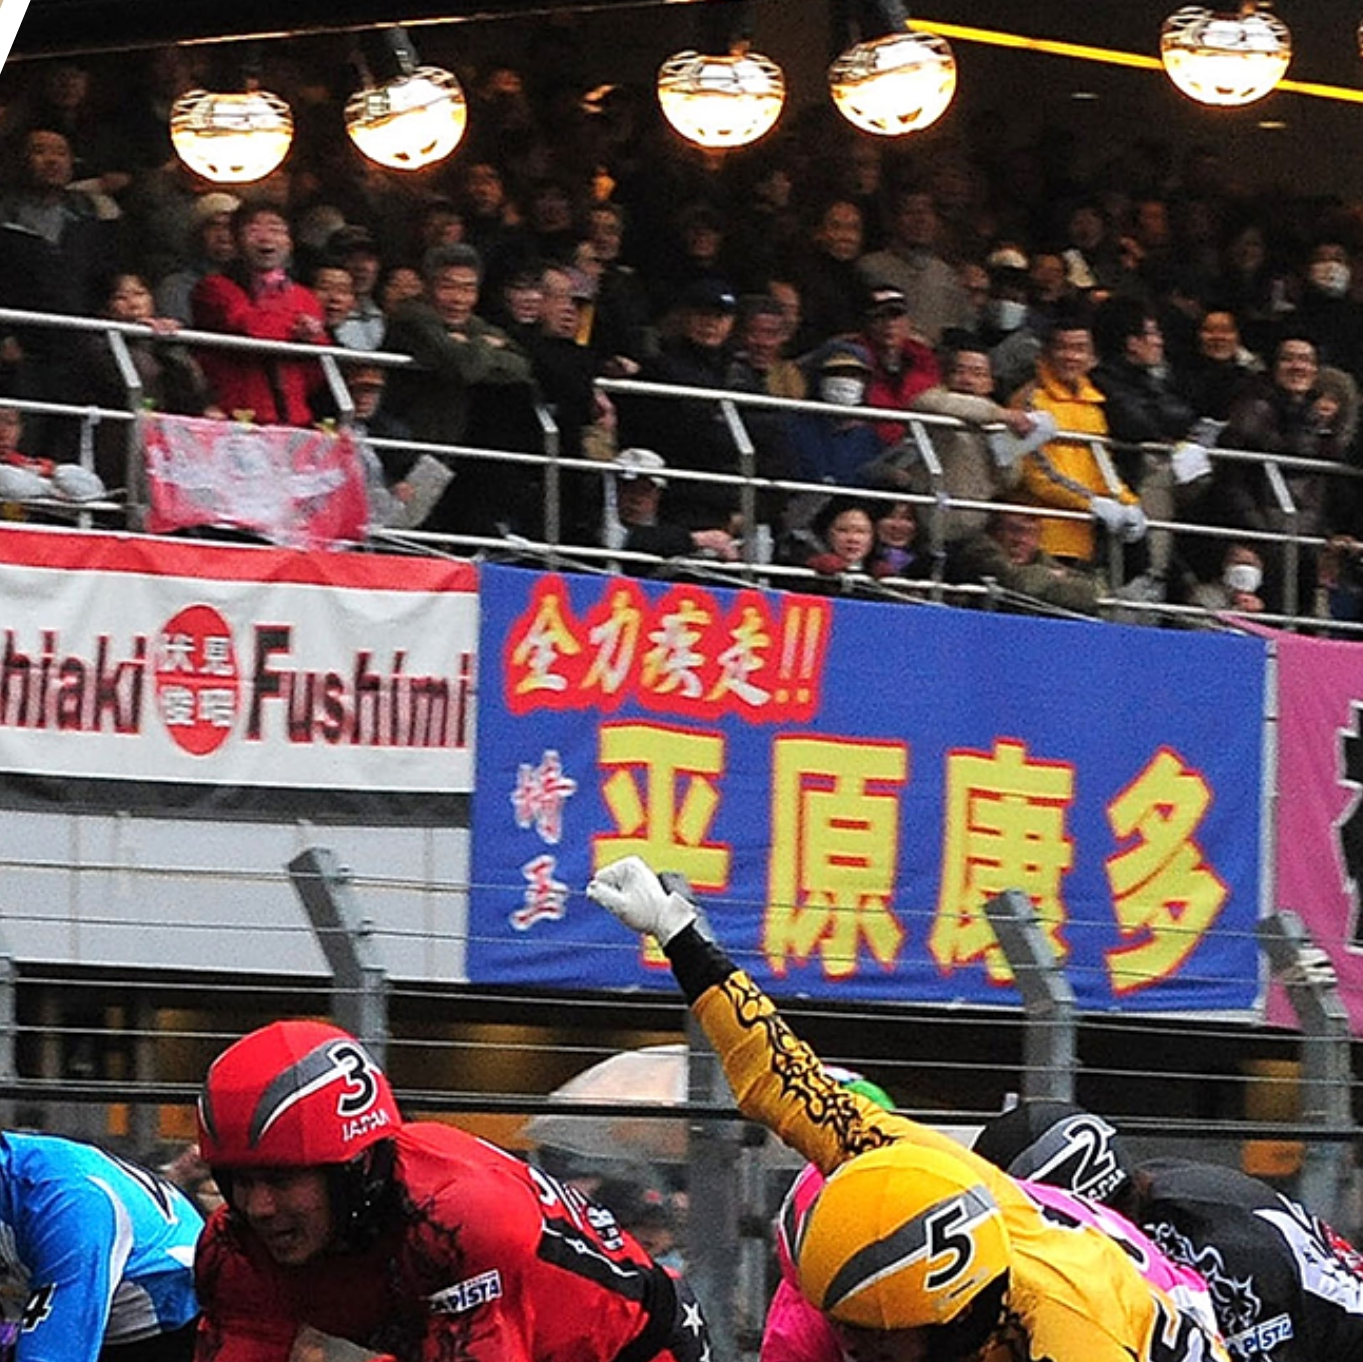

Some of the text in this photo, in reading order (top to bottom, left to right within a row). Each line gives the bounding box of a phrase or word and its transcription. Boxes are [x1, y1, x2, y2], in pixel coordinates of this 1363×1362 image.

[246, 624, 469, 748] Fushimi
[509, 586, 827, 706] 全力疾走!!
[587, 720, 1229, 992] 平原康多
[328, 1042, 377, 1116] 3
[1063, 1119, 1116, 1194] 2
[925, 1199, 974, 1292] 5
[22, 1282, 56, 1332] 4
